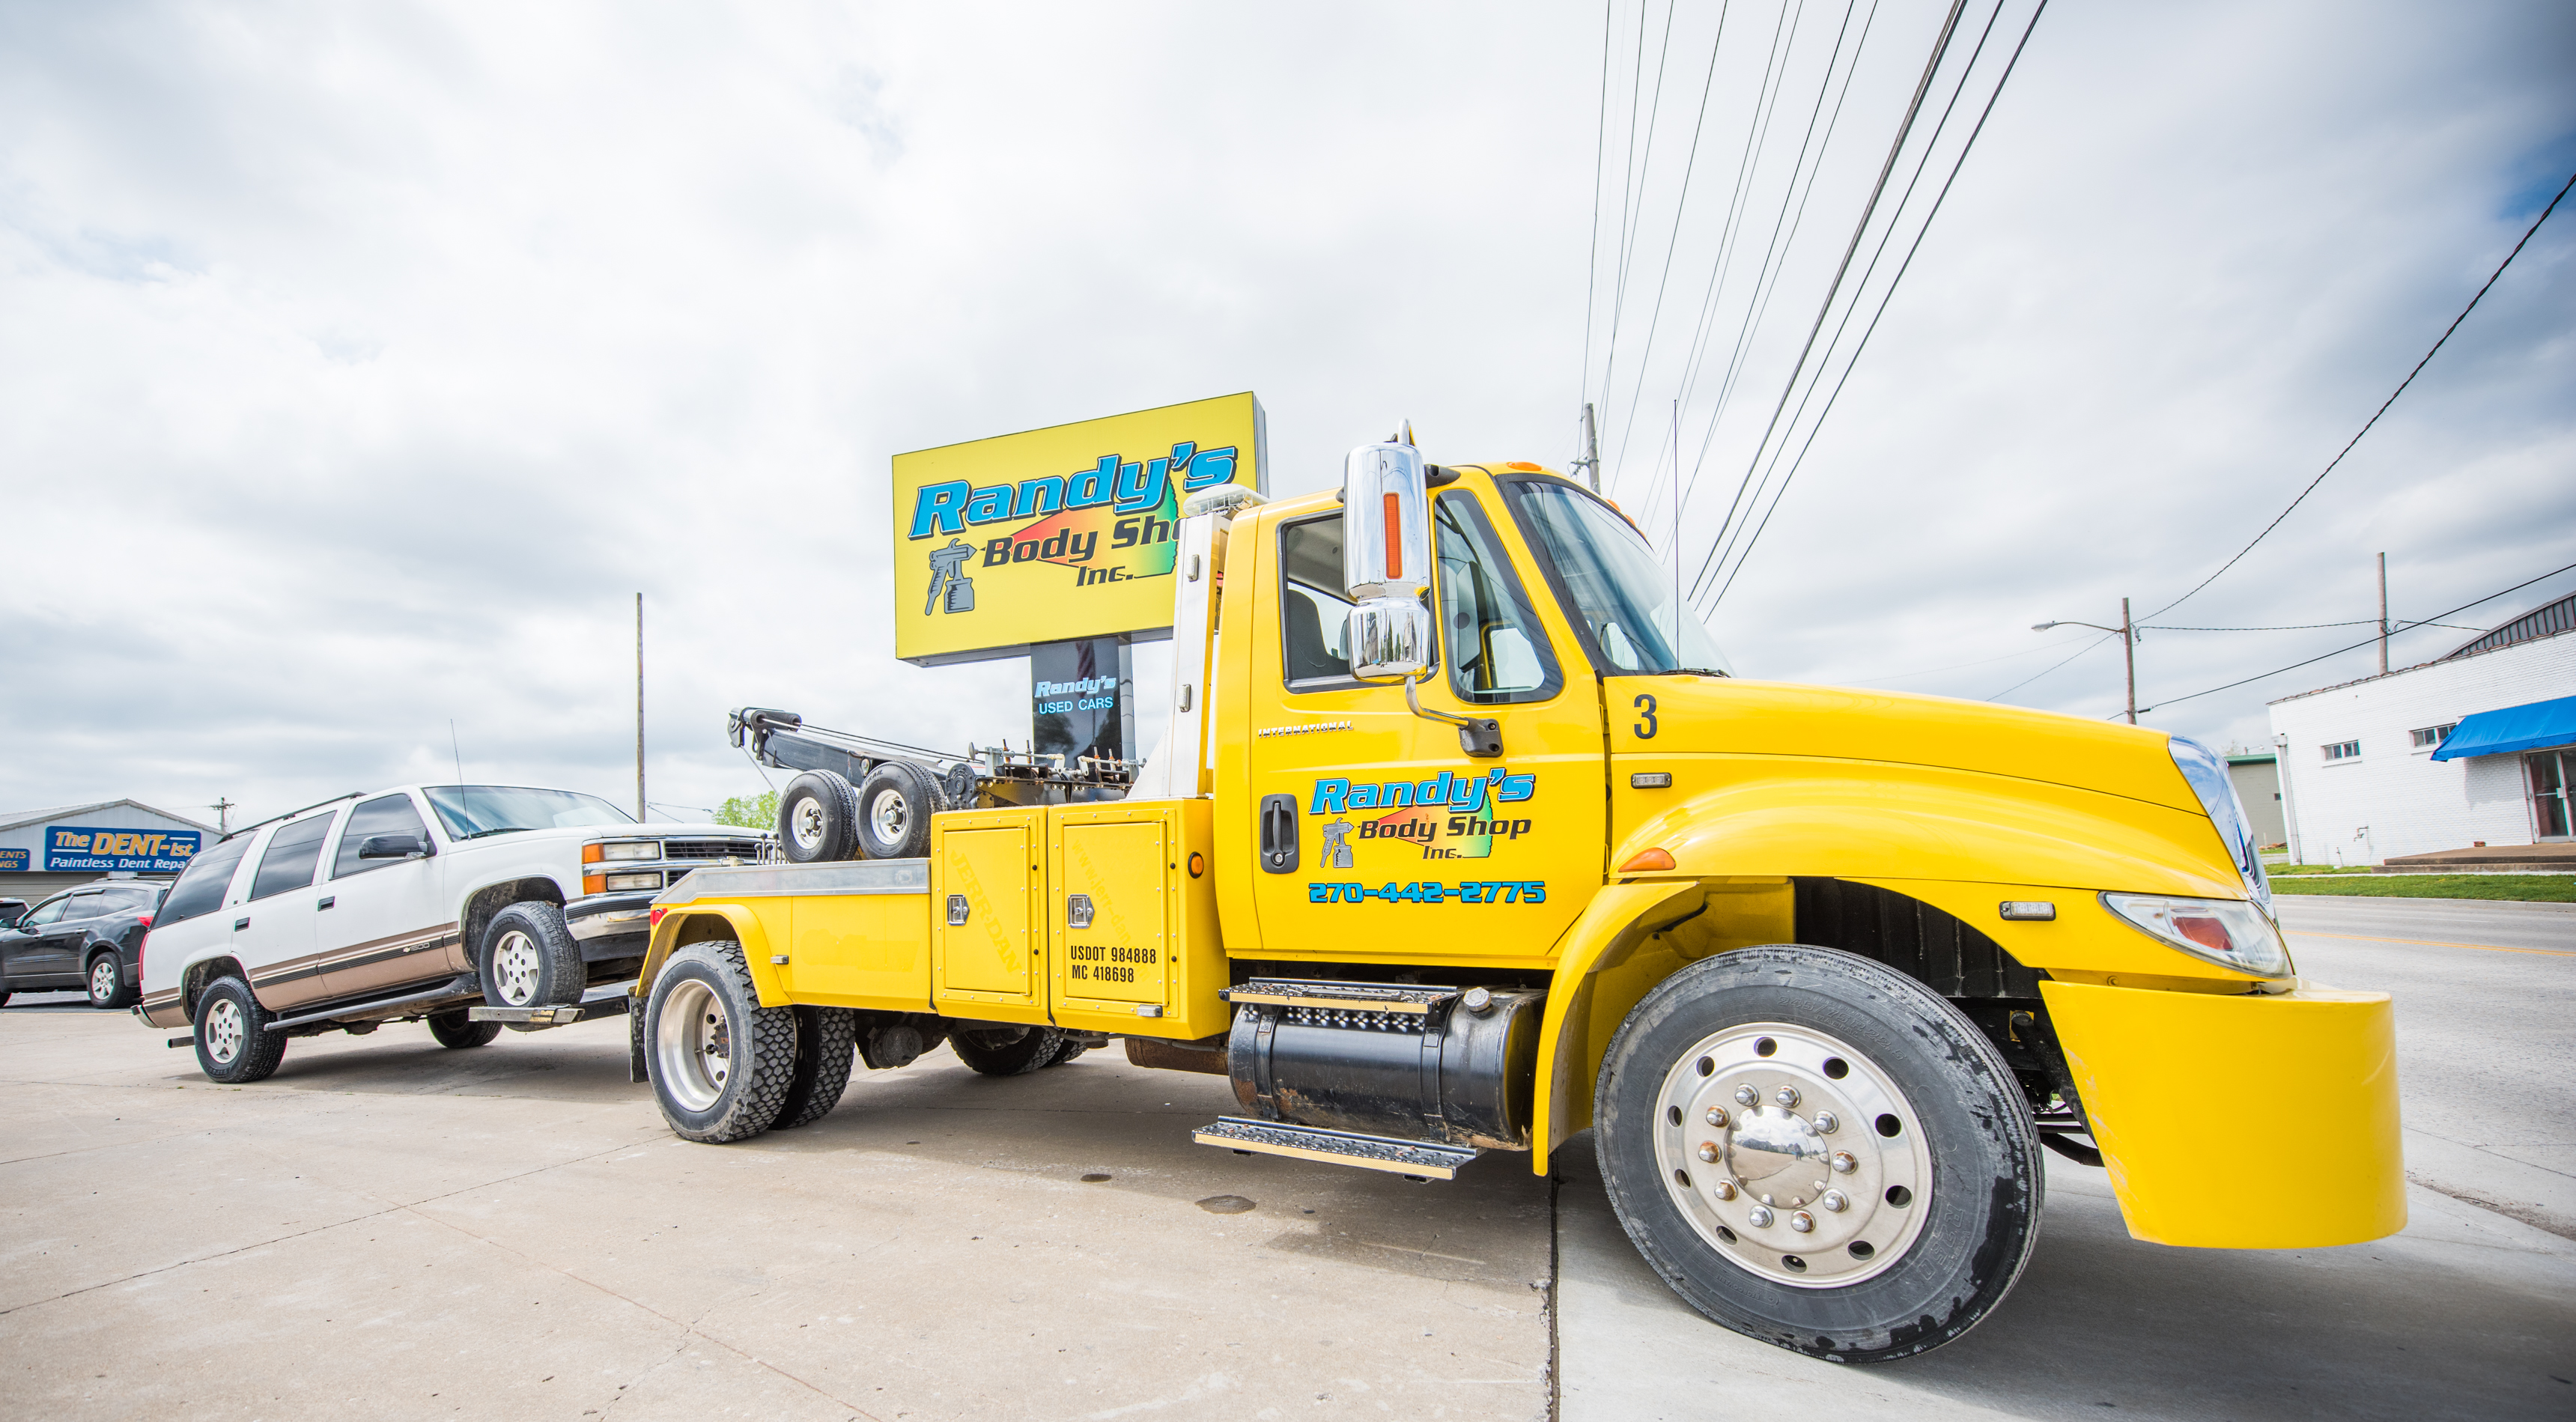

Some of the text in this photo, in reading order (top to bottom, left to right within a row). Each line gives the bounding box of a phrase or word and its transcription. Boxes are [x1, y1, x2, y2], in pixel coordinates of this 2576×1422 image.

[908, 441, 1238, 541] Randy's
[982, 515, 1179, 568] Body Sh
[1076, 565, 1134, 587] Inc.
[1035, 675, 1117, 697] Randy's
[1039, 696, 1114, 714] USED CARS
[1634, 693, 1657, 739] 3
[1258, 720, 1354, 738] INTERNATIONAL
[1308, 767, 1536, 815] Randy's
[1358, 815, 1532, 842] Body Shop
[56, 831, 194, 857] The DENT-ist
[1422, 845, 1462, 860] Inc.
[50, 857, 188, 870] Paintless Dent Repa
[1308, 881, 1546, 904] 270-442-2775
[1071, 945, 1156, 964] USDOT 984888
[1072, 964, 1134, 982] MC 418698
